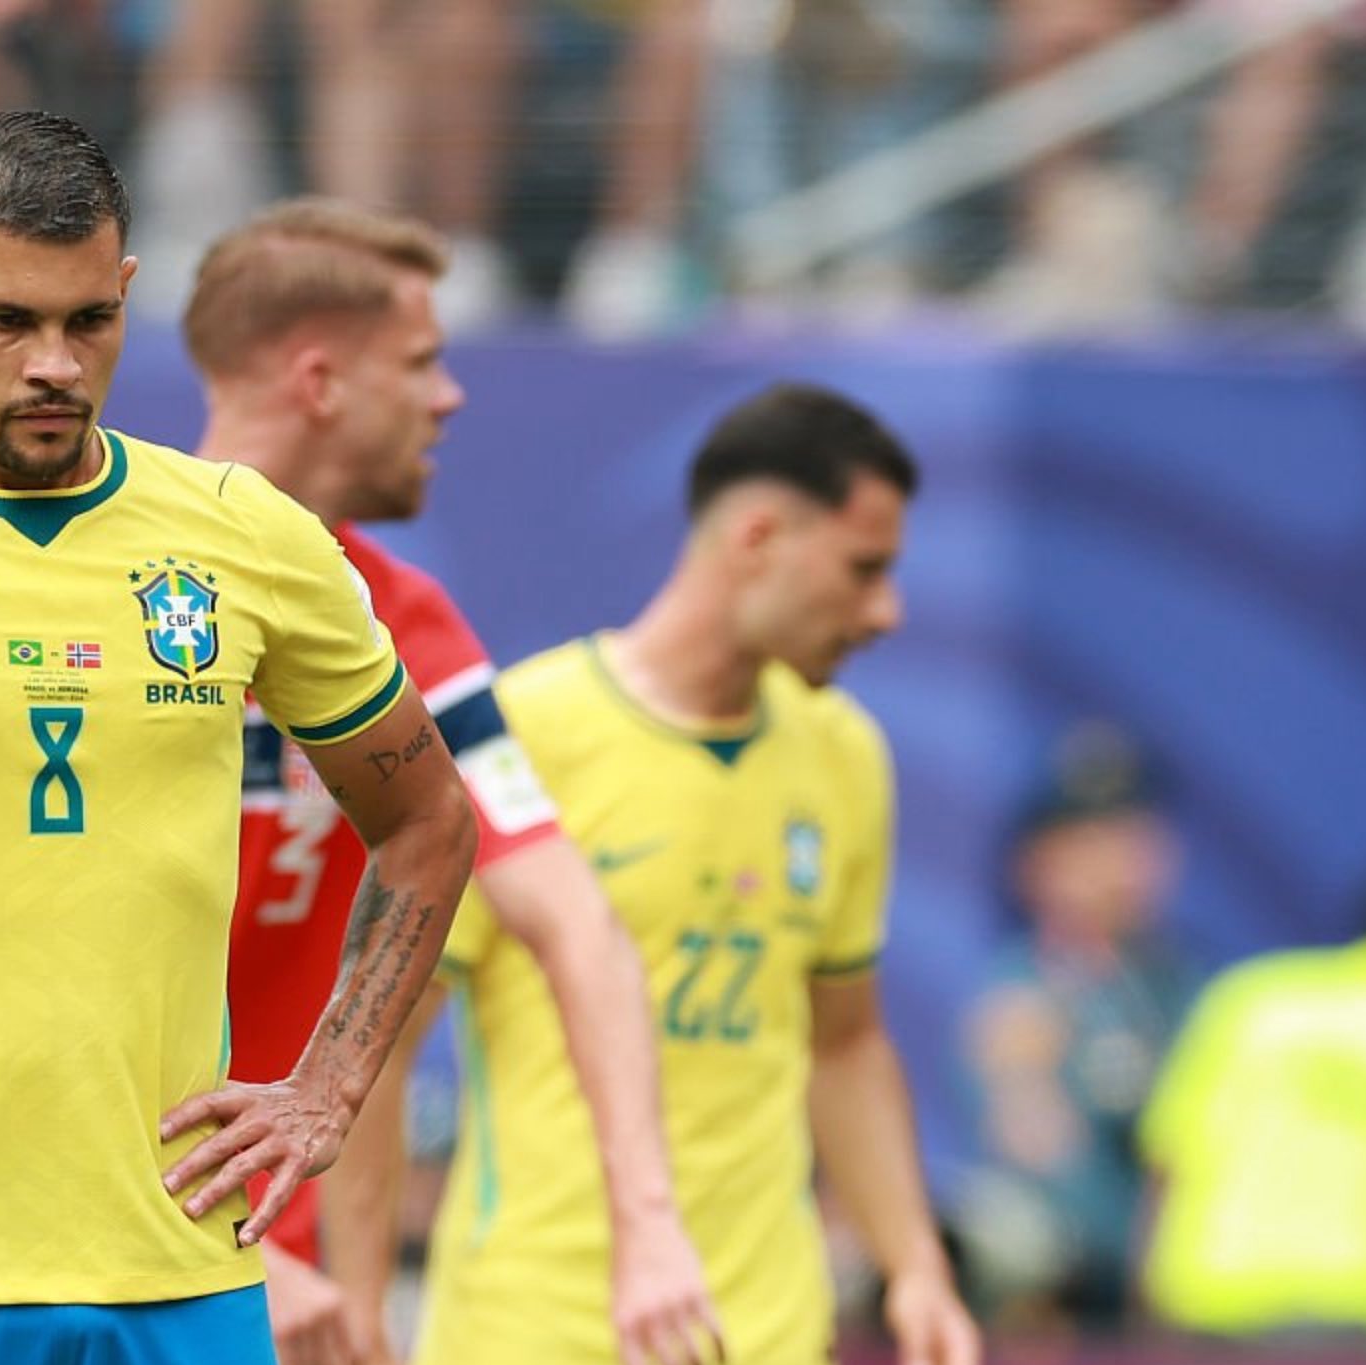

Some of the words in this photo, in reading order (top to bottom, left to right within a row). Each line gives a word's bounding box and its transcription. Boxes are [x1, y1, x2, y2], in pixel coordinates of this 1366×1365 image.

[166, 613, 196, 627] CBF
[146, 683, 226, 705] BRASIL
[29, 707, 84, 833] 8
[255, 797, 343, 925] 3
[663, 930, 767, 1044] 22
